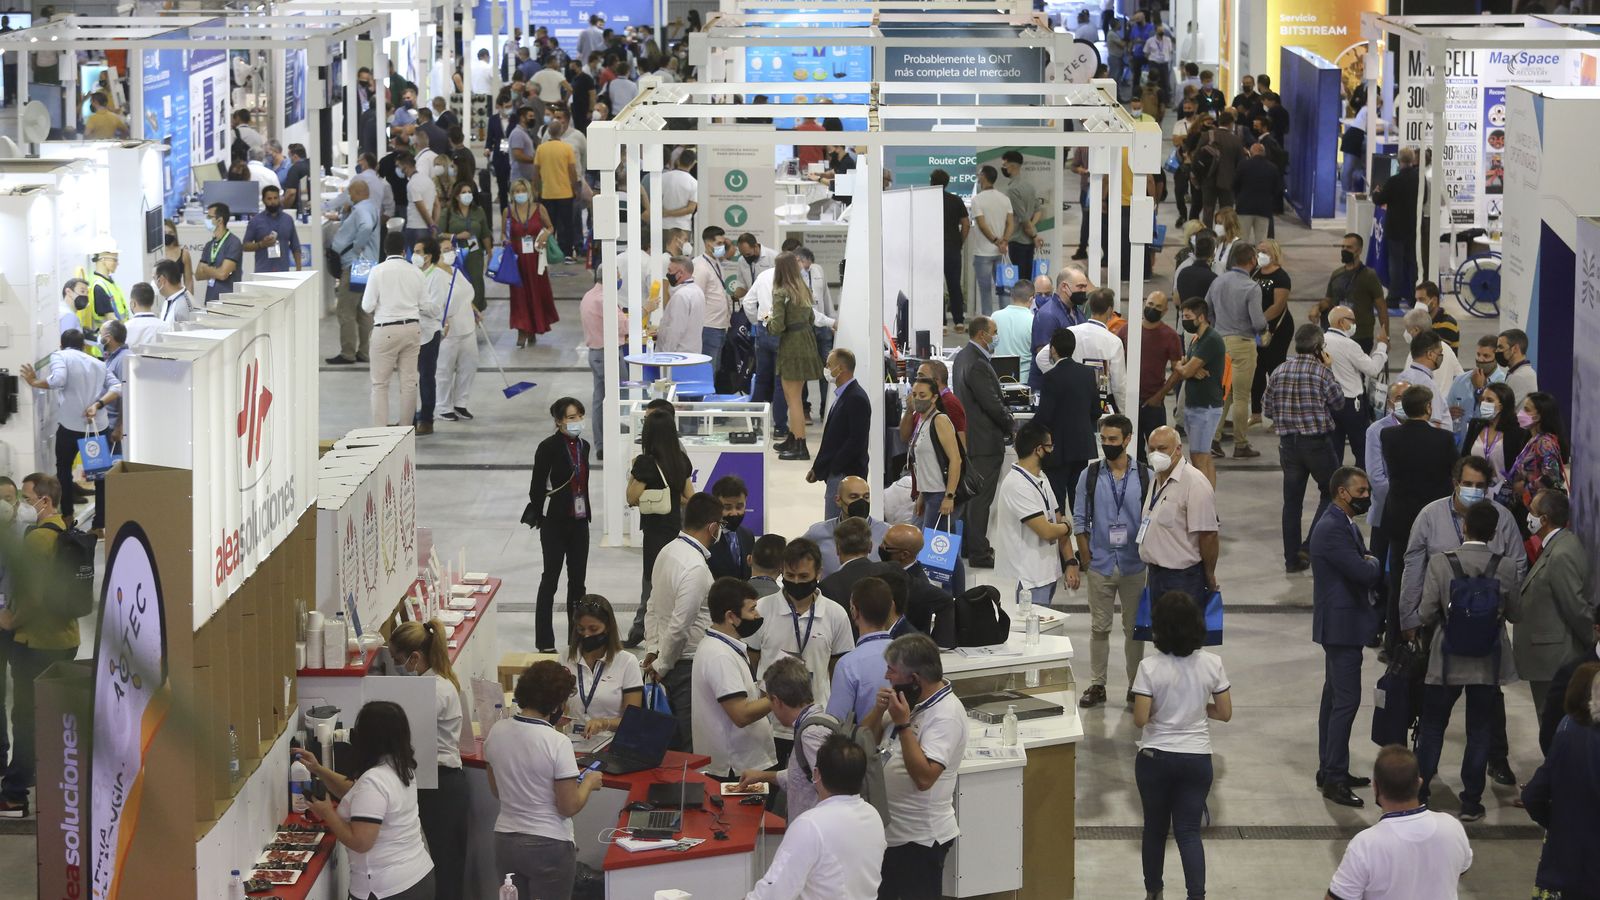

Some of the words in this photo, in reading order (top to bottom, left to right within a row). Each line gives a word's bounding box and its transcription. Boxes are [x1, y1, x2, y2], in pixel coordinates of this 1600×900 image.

[1280, 13, 1317, 22] Servicio
[1280, 25, 1347, 36] BITSTREAM
[903, 54, 976, 64] Probablemente
[978, 54, 986, 64] la
[988, 54, 1013, 64] ONT
[894, 67, 914, 77] más
[916, 67, 960, 80] completa
[963, 67, 977, 77] del
[979, 67, 1021, 77] mercado
[928, 156, 957, 165] Router
